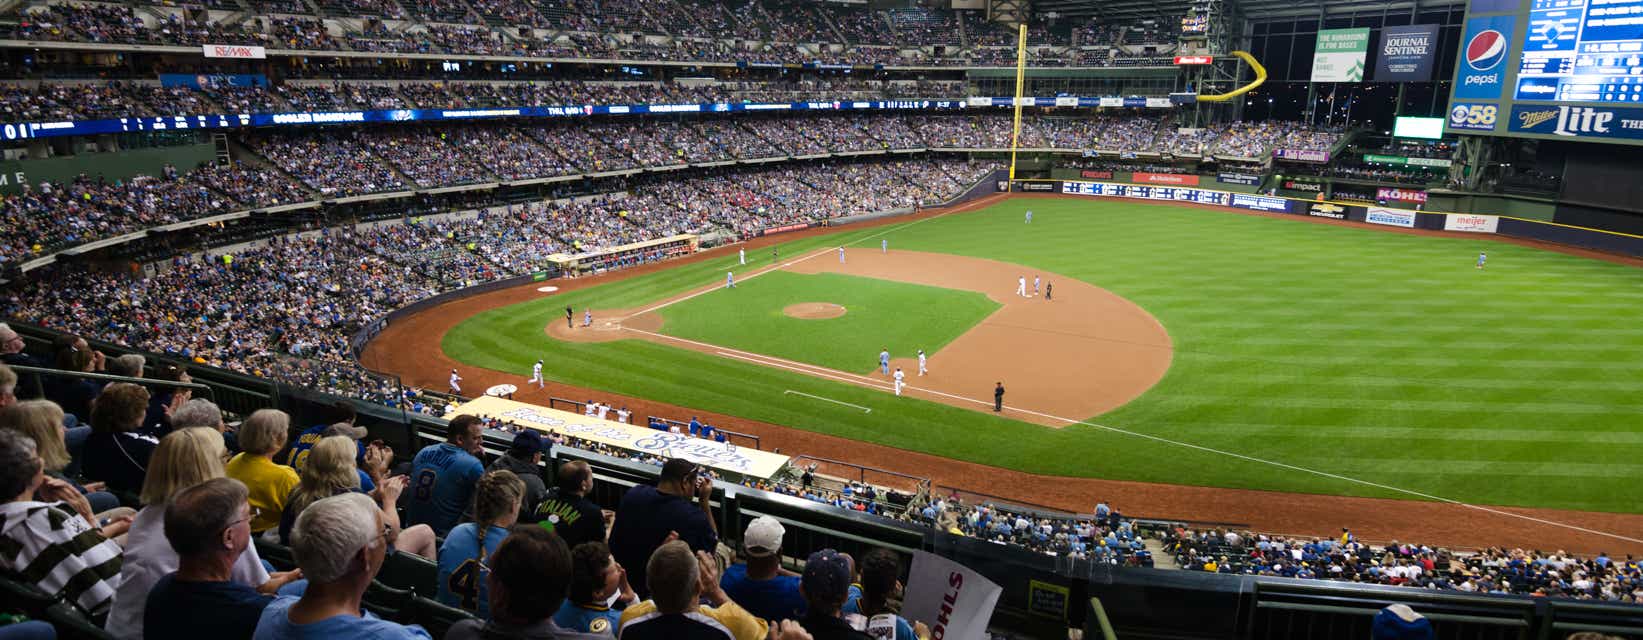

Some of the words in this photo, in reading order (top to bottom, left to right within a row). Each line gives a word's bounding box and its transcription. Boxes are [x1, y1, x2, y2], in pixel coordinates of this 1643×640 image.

[1384, 45, 1428, 55] SENTINEL
[1387, 37, 1429, 47] JOURNAL
[1465, 73, 1498, 86] pepsi
[1467, 105, 1497, 125] 58
[1519, 110, 1558, 128] Miller
[1553, 106, 1613, 136] Lite
[1456, 216, 1486, 225] meijer
[416, 469, 436, 501] 8
[930, 571, 963, 640] OHLS
